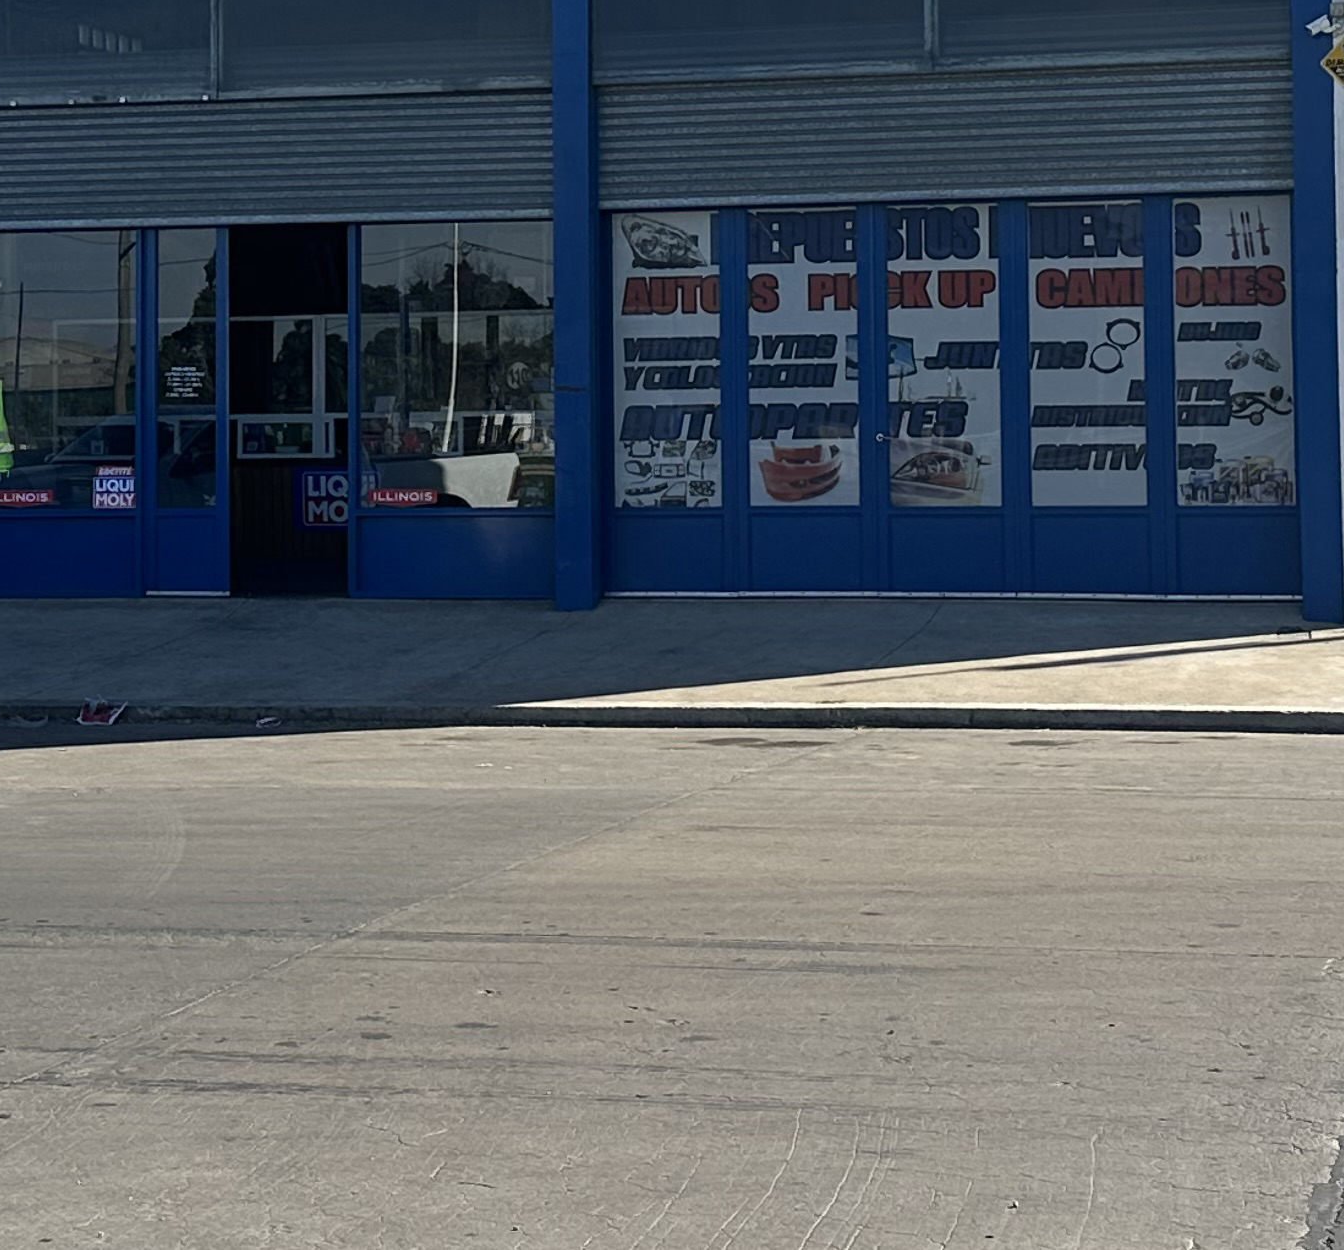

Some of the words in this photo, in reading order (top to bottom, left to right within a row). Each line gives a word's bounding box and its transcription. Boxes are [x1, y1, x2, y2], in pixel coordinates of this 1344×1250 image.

[938, 270, 996, 308] UP
[96, 479, 135, 492] LIQUI
[96, 493, 135, 507] MOLY
[373, 491, 433, 502] ILLINOIS
